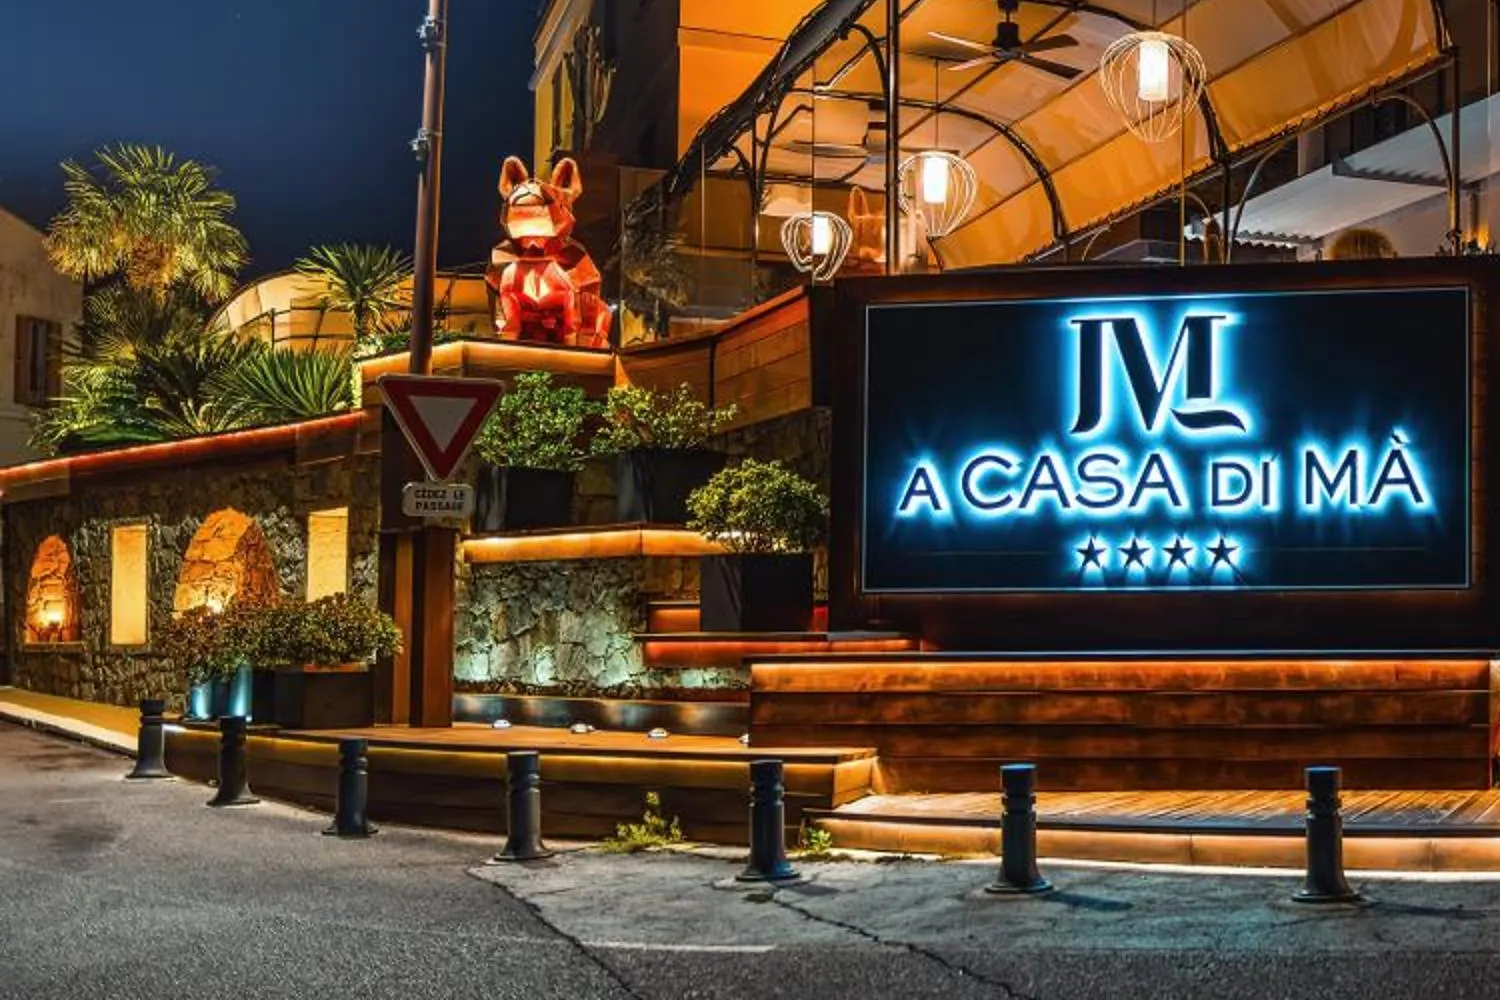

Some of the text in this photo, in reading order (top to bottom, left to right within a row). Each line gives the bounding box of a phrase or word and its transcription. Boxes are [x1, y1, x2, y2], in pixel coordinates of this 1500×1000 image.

[899, 433, 1425, 511] A CASA DI MÀ
